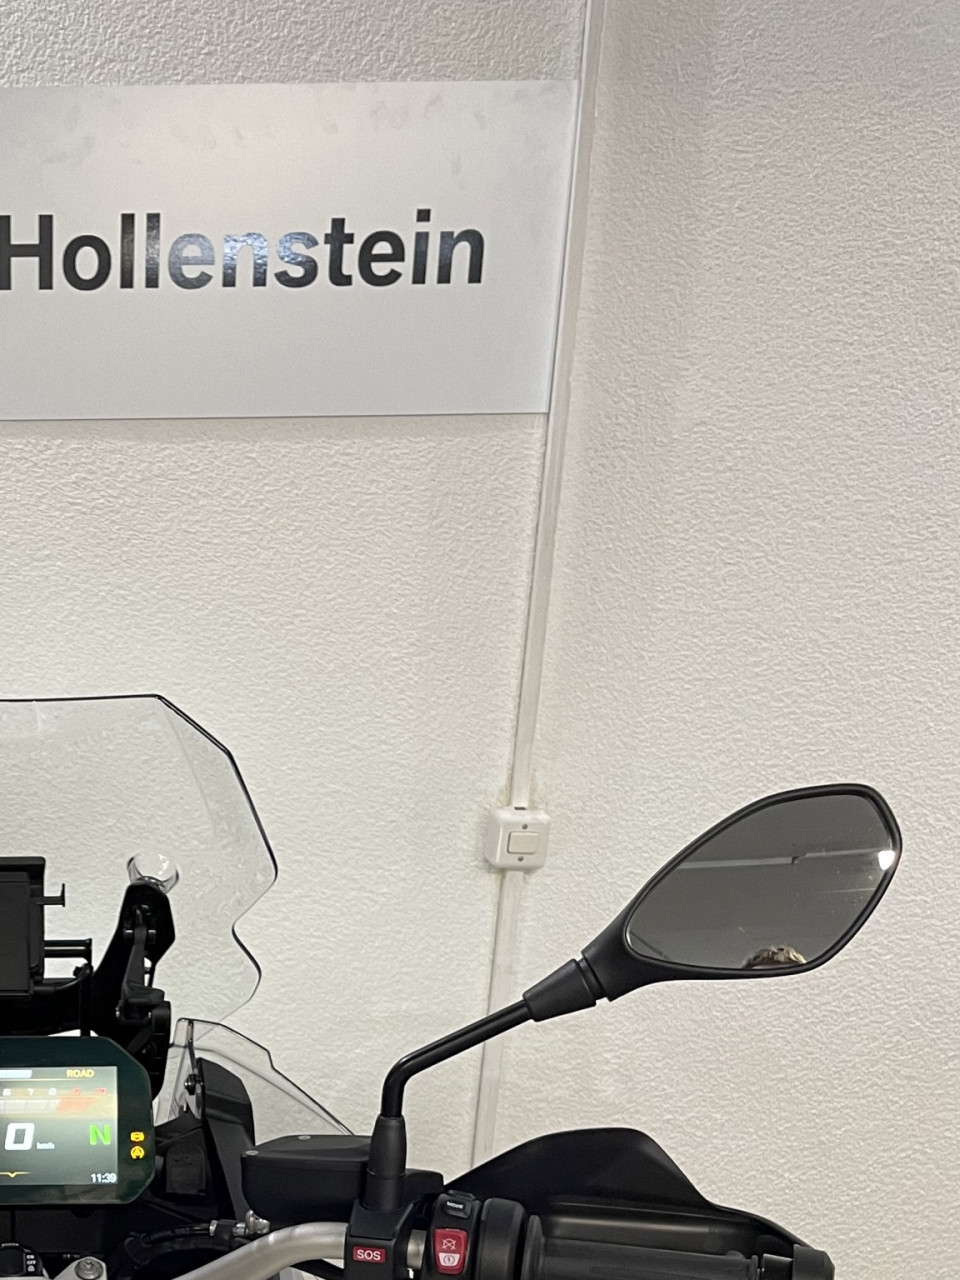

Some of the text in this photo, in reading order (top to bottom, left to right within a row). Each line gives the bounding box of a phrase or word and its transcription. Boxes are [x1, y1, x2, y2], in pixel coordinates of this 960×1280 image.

[66, 1069, 94, 1078] ROAD
[5, 1123, 35, 1150] 0
[89, 1124, 111, 1145] N
[91, 1173, 117, 1183] 11:39
[356, 1249, 381, 1261] SOS
